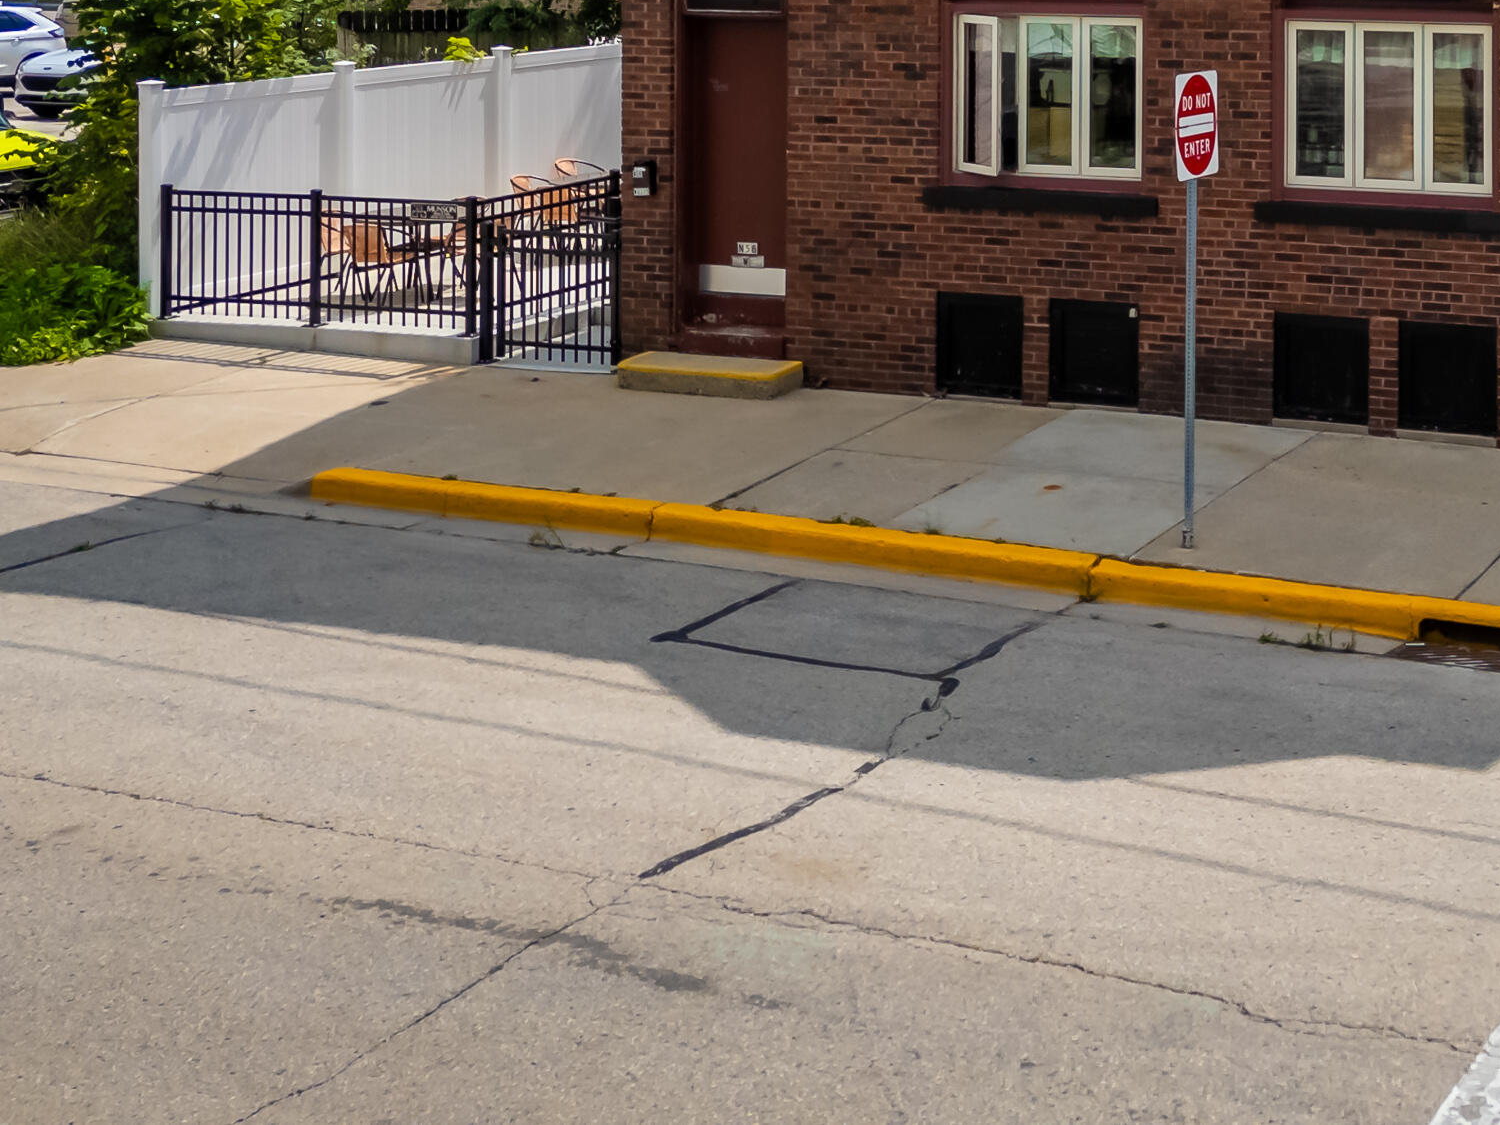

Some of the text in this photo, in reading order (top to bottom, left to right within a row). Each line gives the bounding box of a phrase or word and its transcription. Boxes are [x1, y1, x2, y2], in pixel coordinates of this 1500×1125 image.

[1182, 93, 1211, 111] DO NOT
[1184, 139, 1211, 158] ENTER
